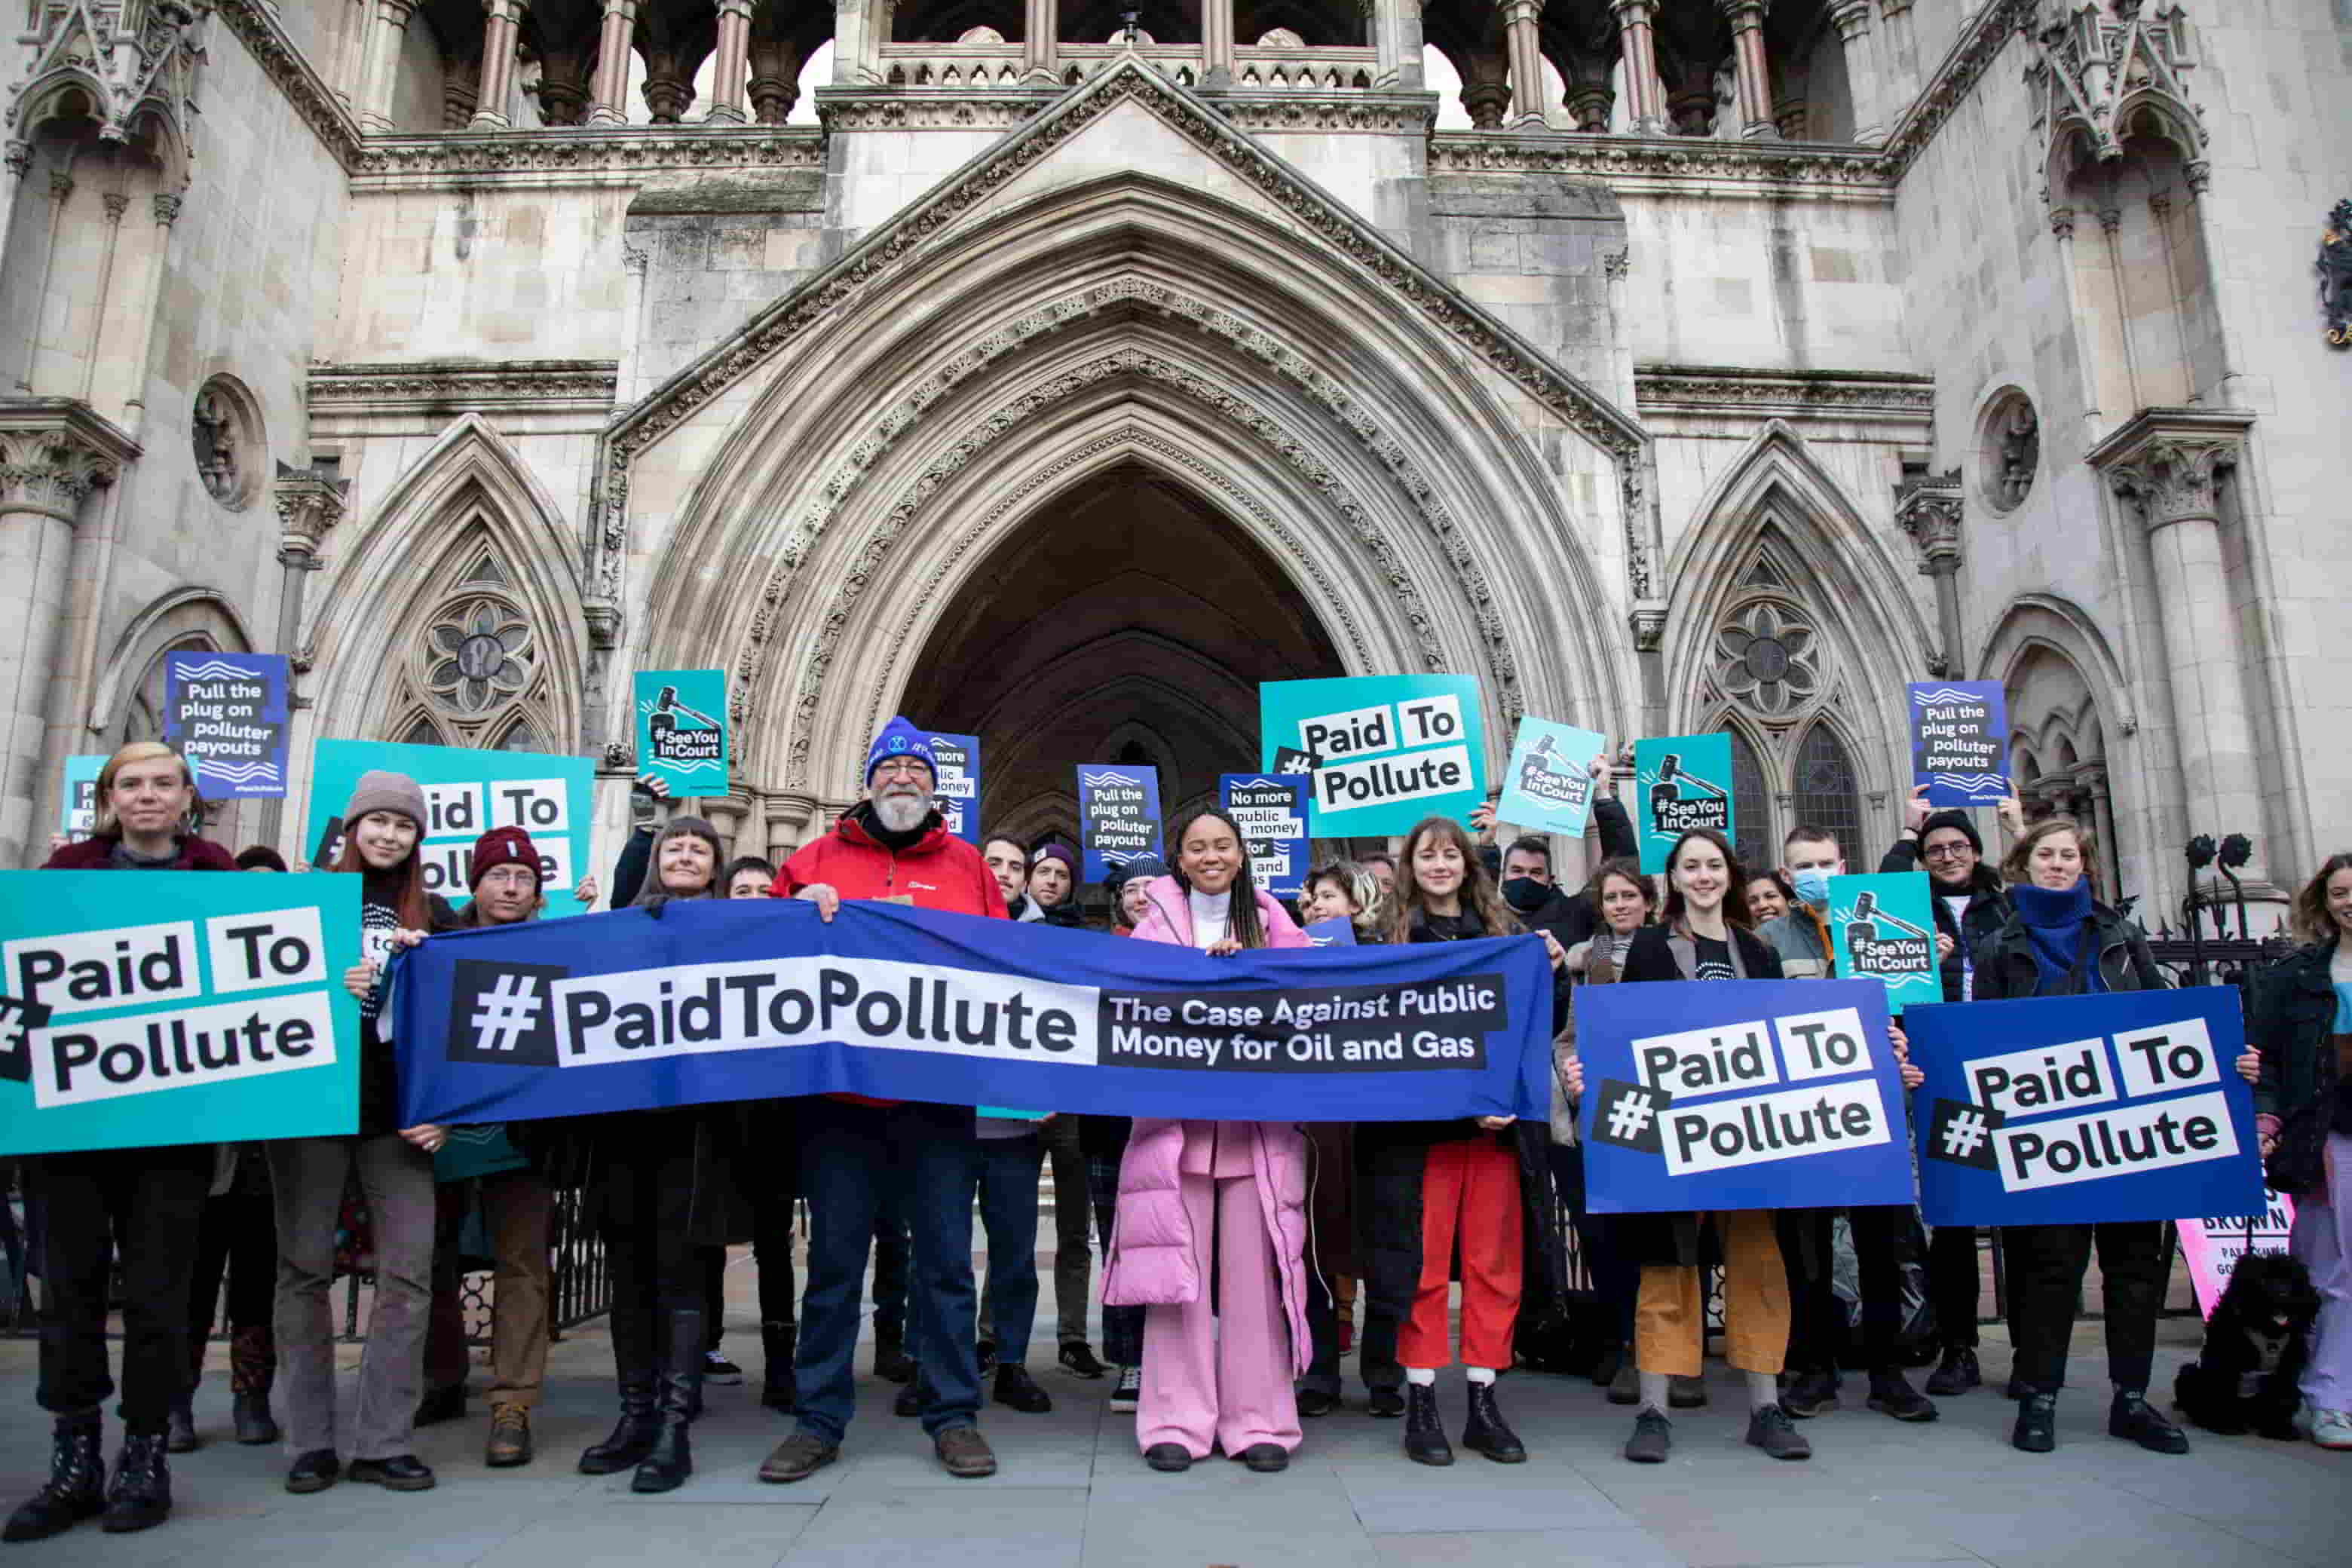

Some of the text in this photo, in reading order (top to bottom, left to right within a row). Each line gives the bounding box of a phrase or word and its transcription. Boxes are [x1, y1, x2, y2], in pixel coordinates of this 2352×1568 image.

[188, 683, 262, 699] Pull the
[180, 701, 253, 720] plug on
[1926, 706, 1984, 720] Pull the
[194, 721, 272, 740] polluter
[654, 726, 718, 743] #SeeYou
[1305, 705, 1455, 755] Paid To
[1922, 722, 1979, 738] plug on
[184, 740, 262, 756] payouts
[660, 742, 718, 757] InCourt
[1934, 739, 1996, 754] polluter
[1927, 756, 1989, 769] payouts
[1324, 757, 1460, 804] Pollute
[1525, 766, 1586, 791] #SeeYou
[1094, 788, 1143, 801] Pull the
[1231, 792, 1292, 805] No more
[1527, 779, 1583, 803] InCourt
[430, 789, 559, 830] id To
[1091, 803, 1138, 818] plug on
[1656, 798, 1725, 816] #SeeYou
[1236, 810, 1279, 822] public
[1662, 814, 1725, 829] InCourt
[1101, 819, 1153, 834] polluter
[1250, 823, 1297, 835] money
[1095, 835, 1146, 848] payouts
[1247, 841, 1266, 854] for
[422, 850, 559, 890] olle
[1257, 860, 1283, 872] and
[1853, 938, 1926, 955] #SeeYou
[19, 924, 311, 1004] Paid To
[1860, 955, 1928, 970] InCourt
[1110, 984, 1496, 1030] The Case Against Public
[52, 1012, 315, 1092] Pollute
[1111, 1025, 1475, 1066] Money for Oil and Gas
[1643, 1022, 1857, 1090] Paid To
[1975, 1035, 2204, 1110] Paid To
[1607, 1090, 1654, 1140] #
[1674, 1095, 1872, 1163] Pollute
[1942, 1110, 1987, 1157] #
[2008, 1111, 2219, 1179] Pollute
